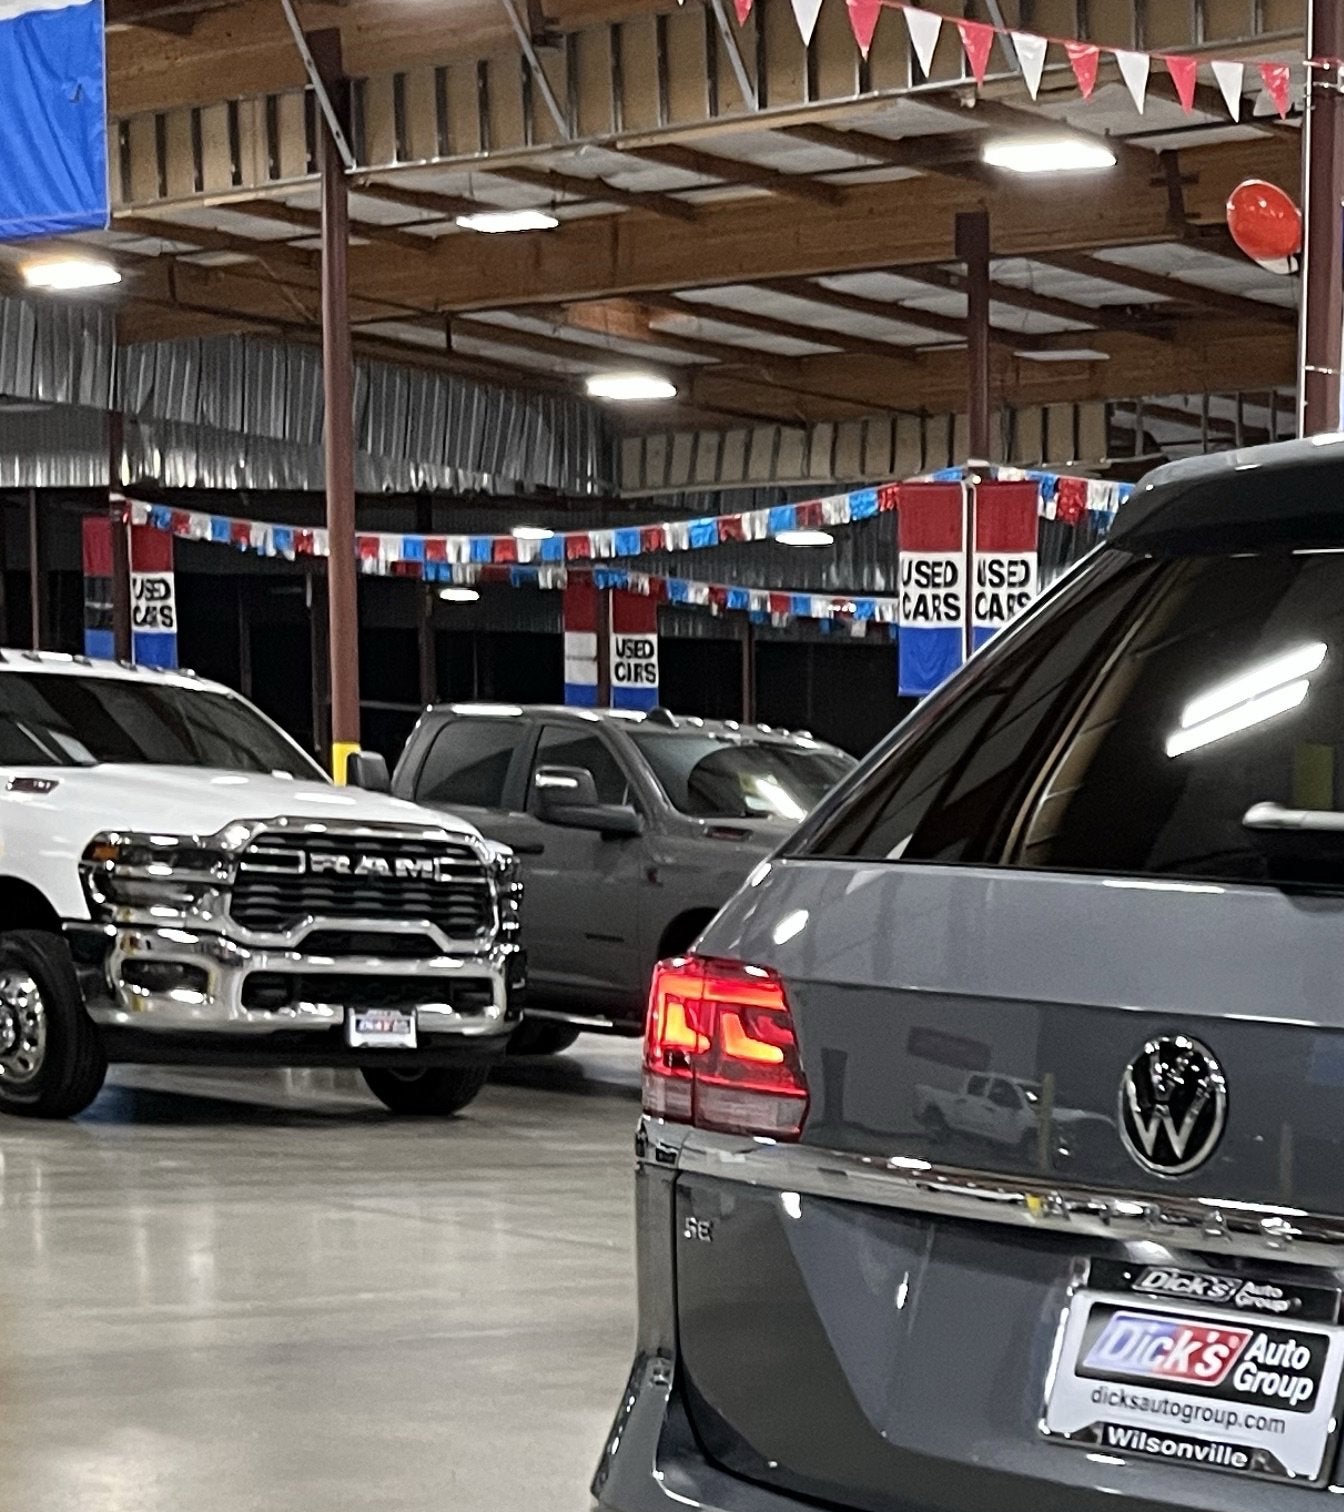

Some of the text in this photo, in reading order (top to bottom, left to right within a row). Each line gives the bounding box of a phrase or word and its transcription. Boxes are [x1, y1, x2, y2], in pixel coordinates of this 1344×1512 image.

[901, 559, 958, 588] USED
[977, 559, 1030, 588] USED
[903, 592, 961, 621] CARS
[615, 637, 655, 659] USED
[310, 853, 433, 878] RAM
[1101, 1319, 1230, 1378] Dick's
[1244, 1332, 1311, 1370] Auto
[1233, 1364, 1315, 1406] Group
[1091, 1385, 1286, 1434] dicksautogroup.com
[1107, 1425, 1248, 1468] Wilsonville
